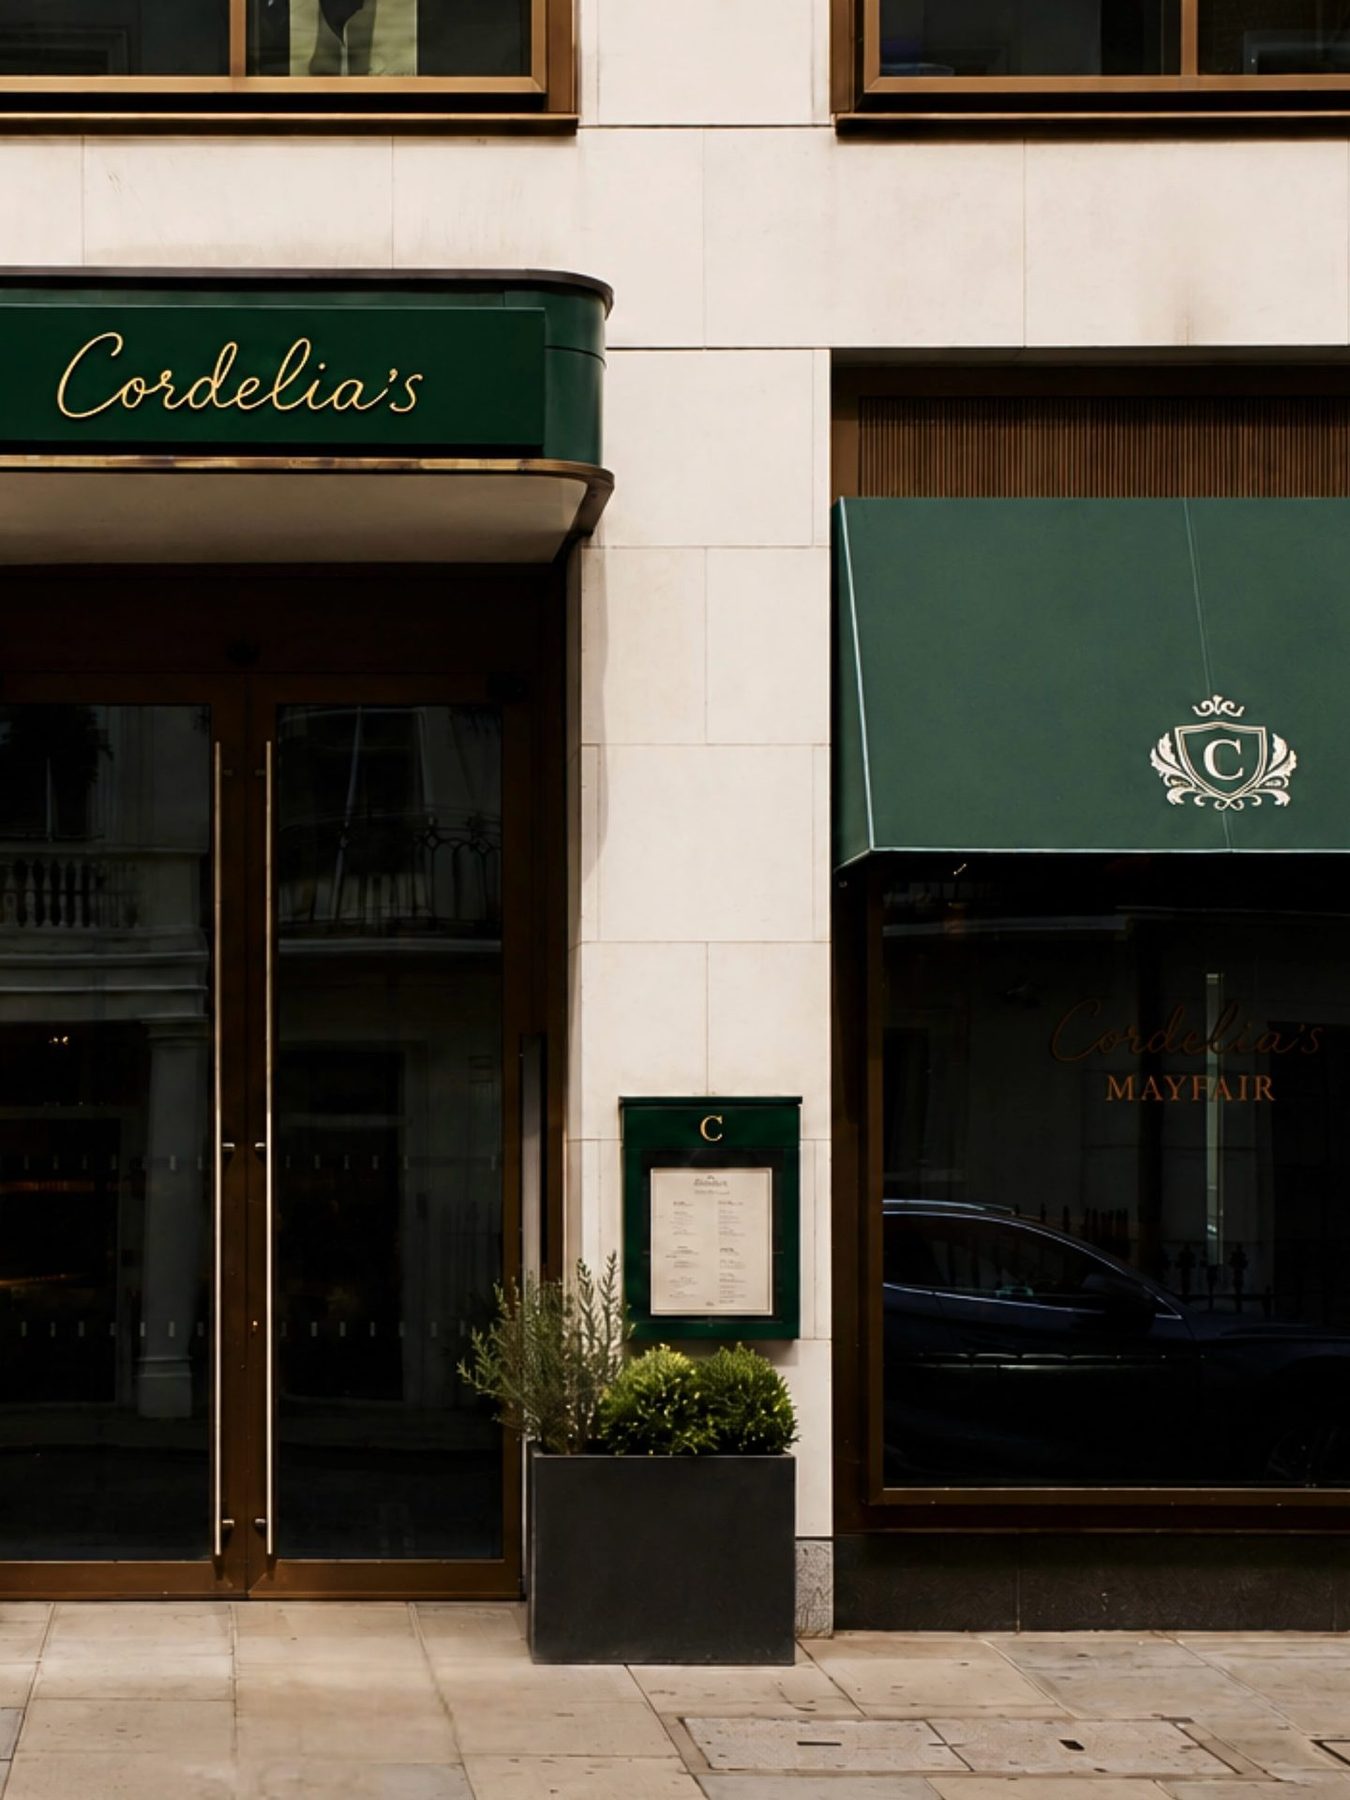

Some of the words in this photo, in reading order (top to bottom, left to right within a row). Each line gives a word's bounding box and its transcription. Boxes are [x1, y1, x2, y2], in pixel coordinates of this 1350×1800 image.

[56, 331, 424, 418] Cordelia's
[1203, 739, 1244, 780] C
[1051, 999, 1323, 1062] Cordelia's
[1105, 1075, 1275, 1101] MAYFAIR
[700, 1115, 723, 1142] C
